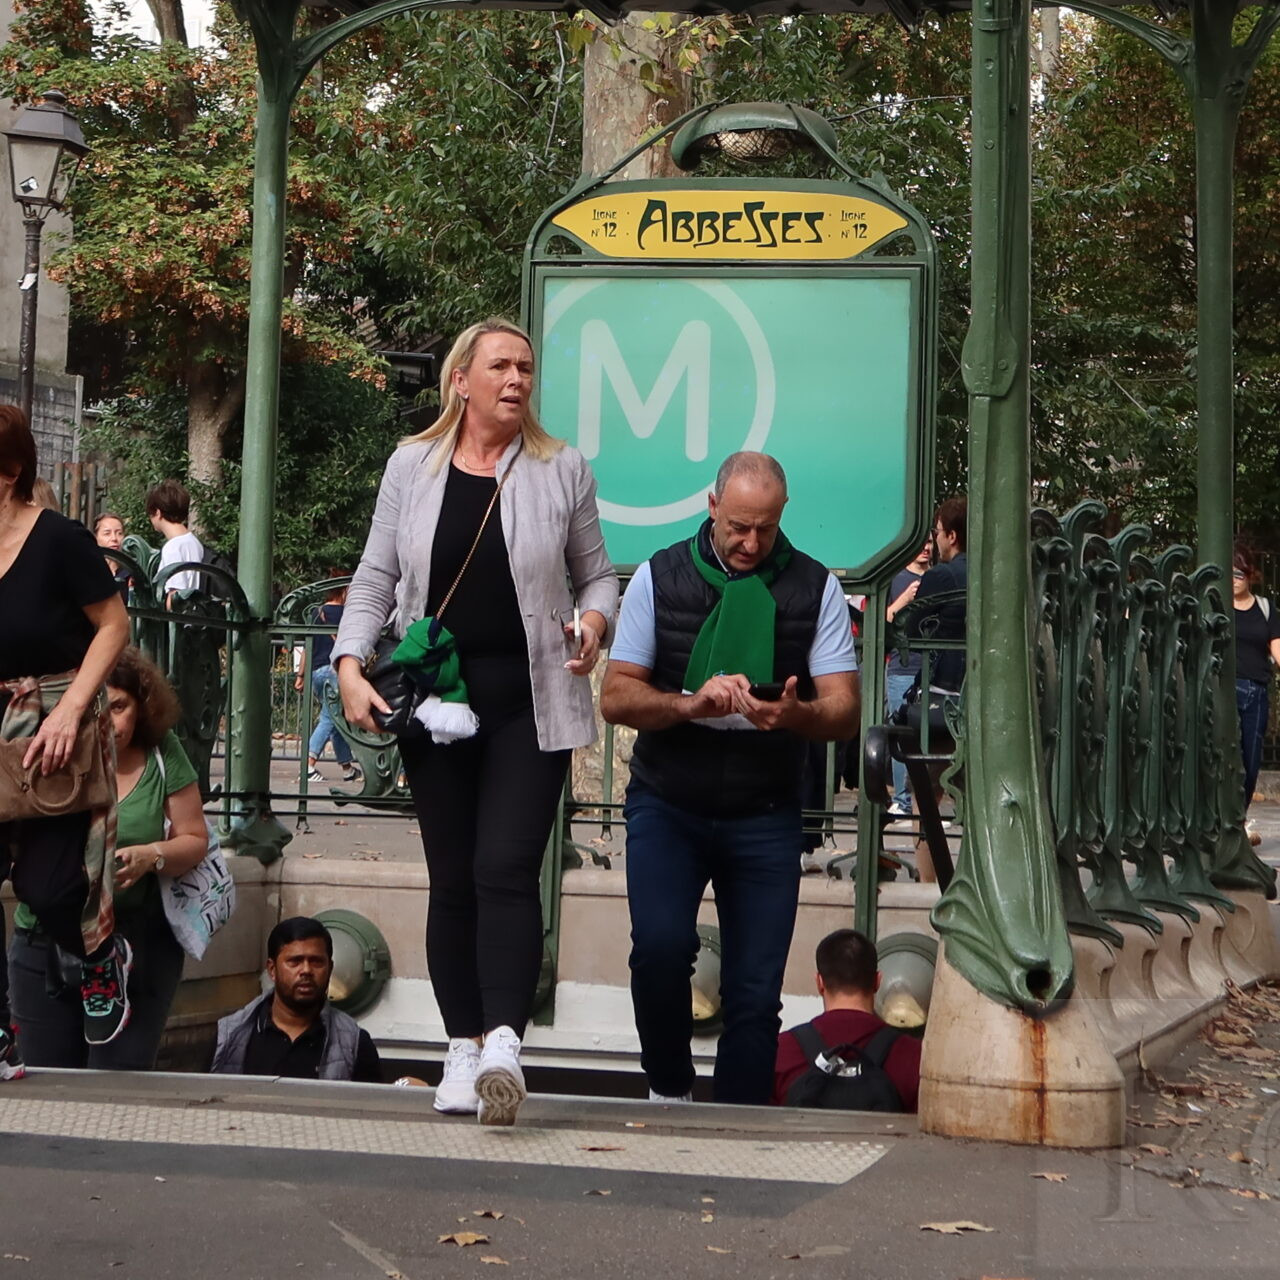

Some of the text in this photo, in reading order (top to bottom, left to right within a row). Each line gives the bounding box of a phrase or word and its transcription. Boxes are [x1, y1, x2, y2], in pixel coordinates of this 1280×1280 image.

[592, 209, 617, 221] LIGNE
[841, 210, 866, 222] LIGNE
[602, 222, 617, 238] 12
[637, 198, 825, 250] ABBESSES
[852, 223, 868, 239] 12
[577, 319, 712, 463] M
